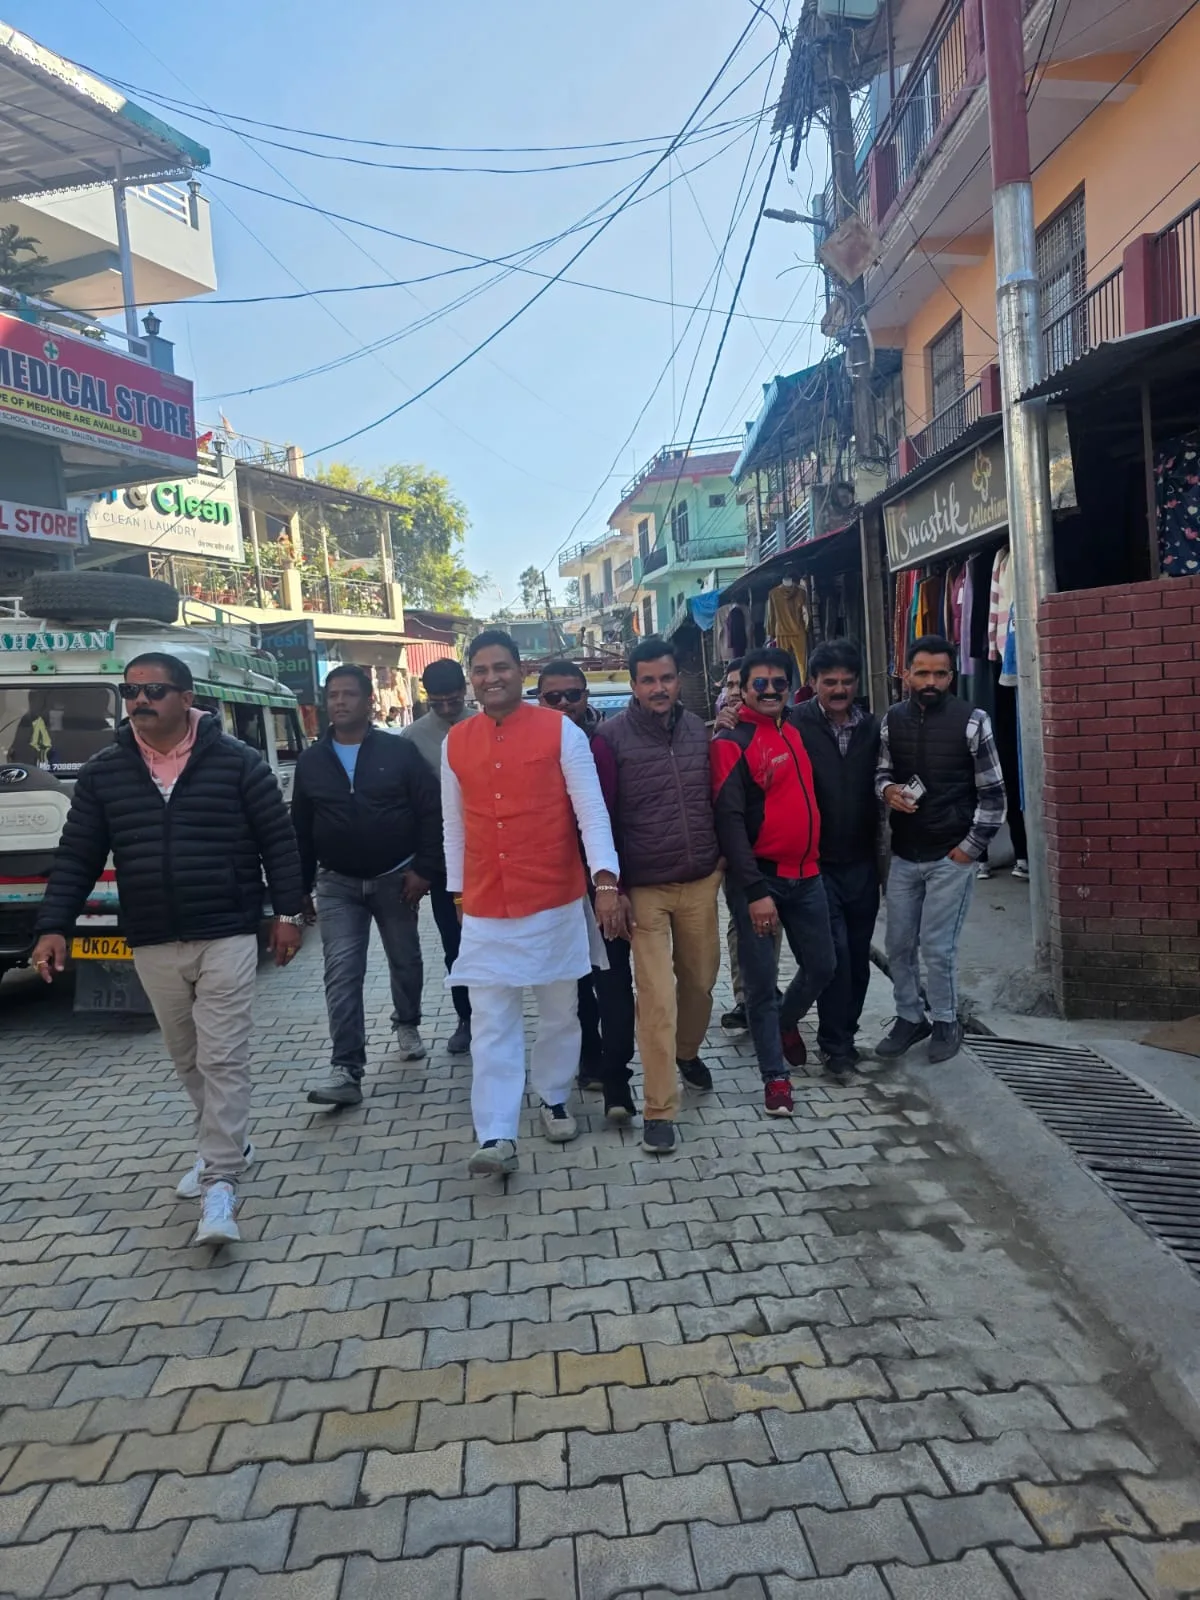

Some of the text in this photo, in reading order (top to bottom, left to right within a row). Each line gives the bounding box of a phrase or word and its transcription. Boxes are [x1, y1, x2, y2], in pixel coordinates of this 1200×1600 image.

[11, 396, 25, 407] OF
[26, 400, 72, 419] MEDICINE
[73, 413, 91, 426] ARE
[93, 417, 138, 438] AVAILABLE
[114, 384, 193, 440] STORE
[154, 483, 232, 524] Clean
[899, 482, 968, 560] Swastik
[15, 508, 78, 538] STORE
[102, 512, 140, 526] CLEAN
[149, 519, 197, 538] LAUNDRY
[263, 630, 305, 647] resh
[277, 658, 309, 673] ean
